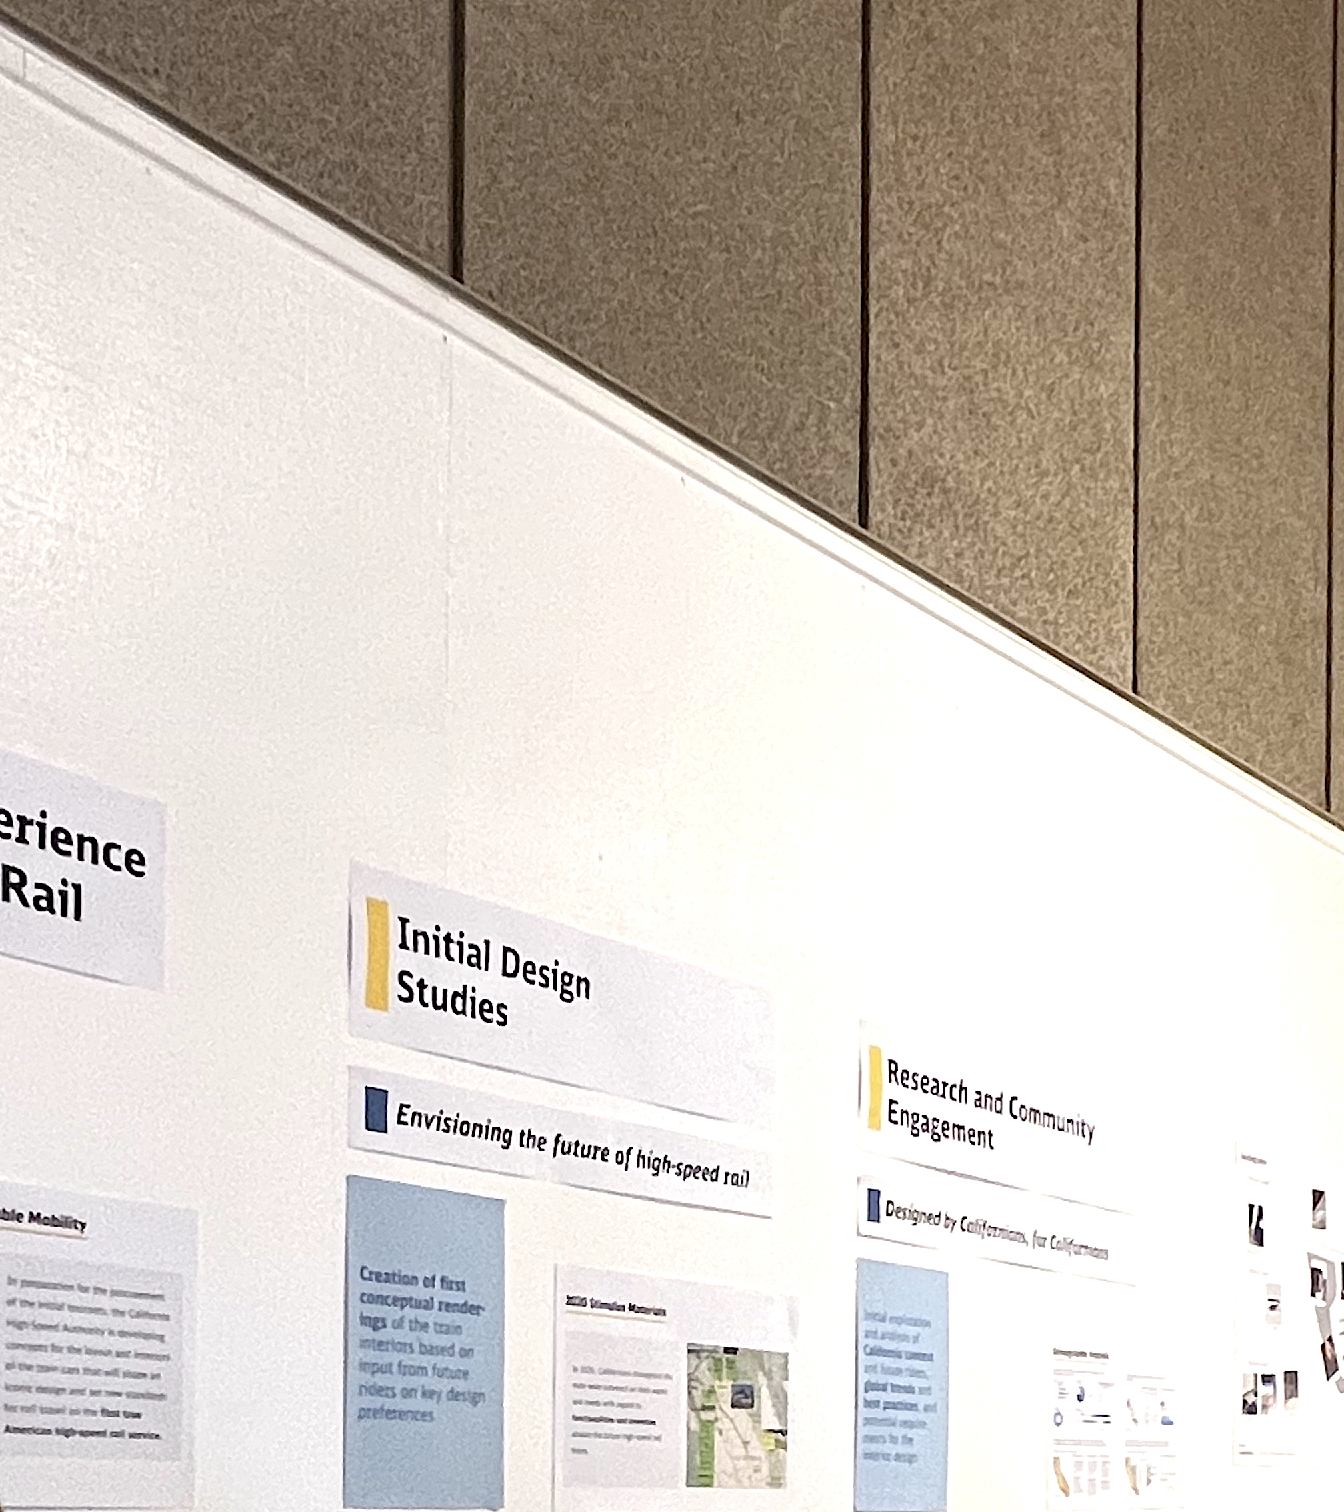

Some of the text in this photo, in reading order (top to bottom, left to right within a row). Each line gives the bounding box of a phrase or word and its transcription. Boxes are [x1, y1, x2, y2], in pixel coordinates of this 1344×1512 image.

[1, 863, 82, 921] Rail
[398, 916, 591, 1004] Initial Design
[398, 970, 508, 1027] Studies
[888, 1058, 1095, 1146] Research and Community
[888, 1099, 994, 1150] Engagement
[396, 1102, 749, 1188] Envisioning the future of high-speed rail
[29, 1210, 87, 1233] Mobility
[886, 1200, 941, 1226] Designed
[944, 1211, 957, 1233] by
[360, 1265, 466, 1292] Creation of first
[360, 1292, 433, 1311] conceptual
